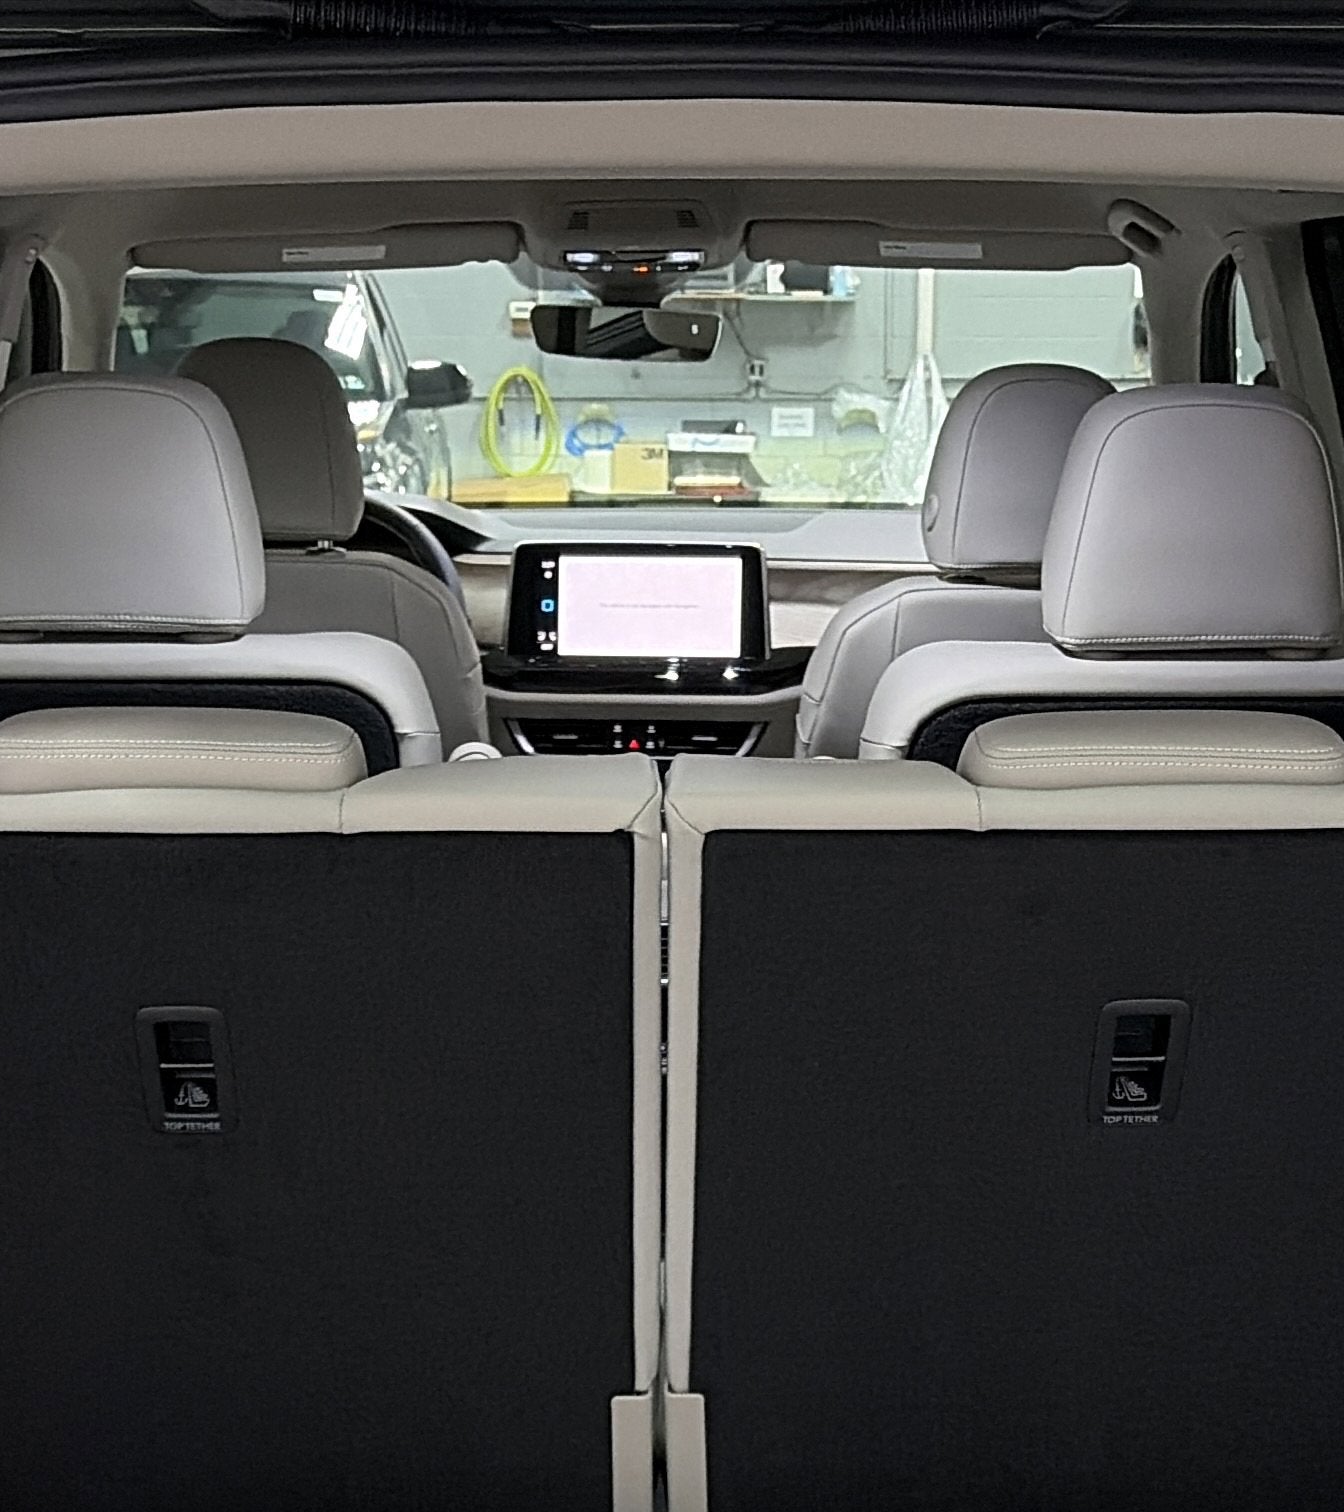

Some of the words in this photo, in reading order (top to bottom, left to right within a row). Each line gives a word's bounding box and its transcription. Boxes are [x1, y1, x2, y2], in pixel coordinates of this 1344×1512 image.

[641, 448, 664, 460] 3M
[1102, 1115, 1122, 1124] TOP
[1123, 1115, 1158, 1123] TETHER
[163, 1122, 183, 1131] TOP
[185, 1122, 221, 1131] TETHER
